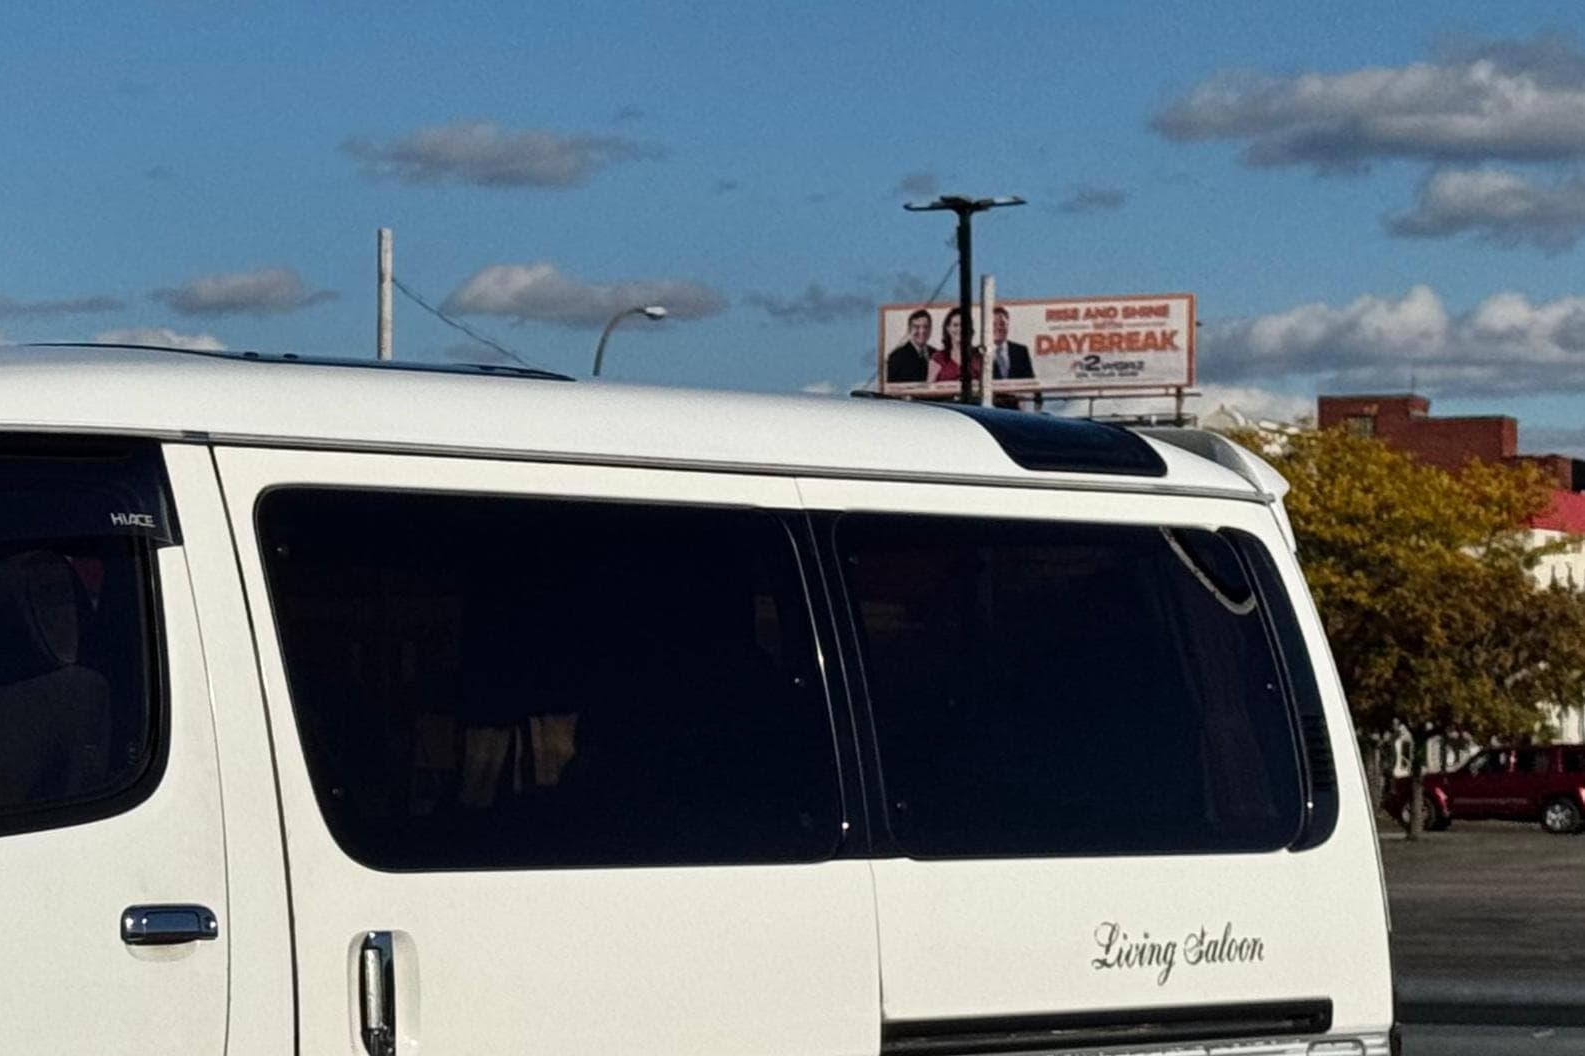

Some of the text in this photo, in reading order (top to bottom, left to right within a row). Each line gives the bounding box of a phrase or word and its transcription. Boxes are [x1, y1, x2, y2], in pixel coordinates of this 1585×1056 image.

[1083, 306, 1118, 320] AND
[1035, 330, 1180, 356] DAYBREAK
[1084, 355, 1101, 371] 2
[110, 512, 156, 528] HIACE
[1091, 921, 1265, 987] Living Saloon
